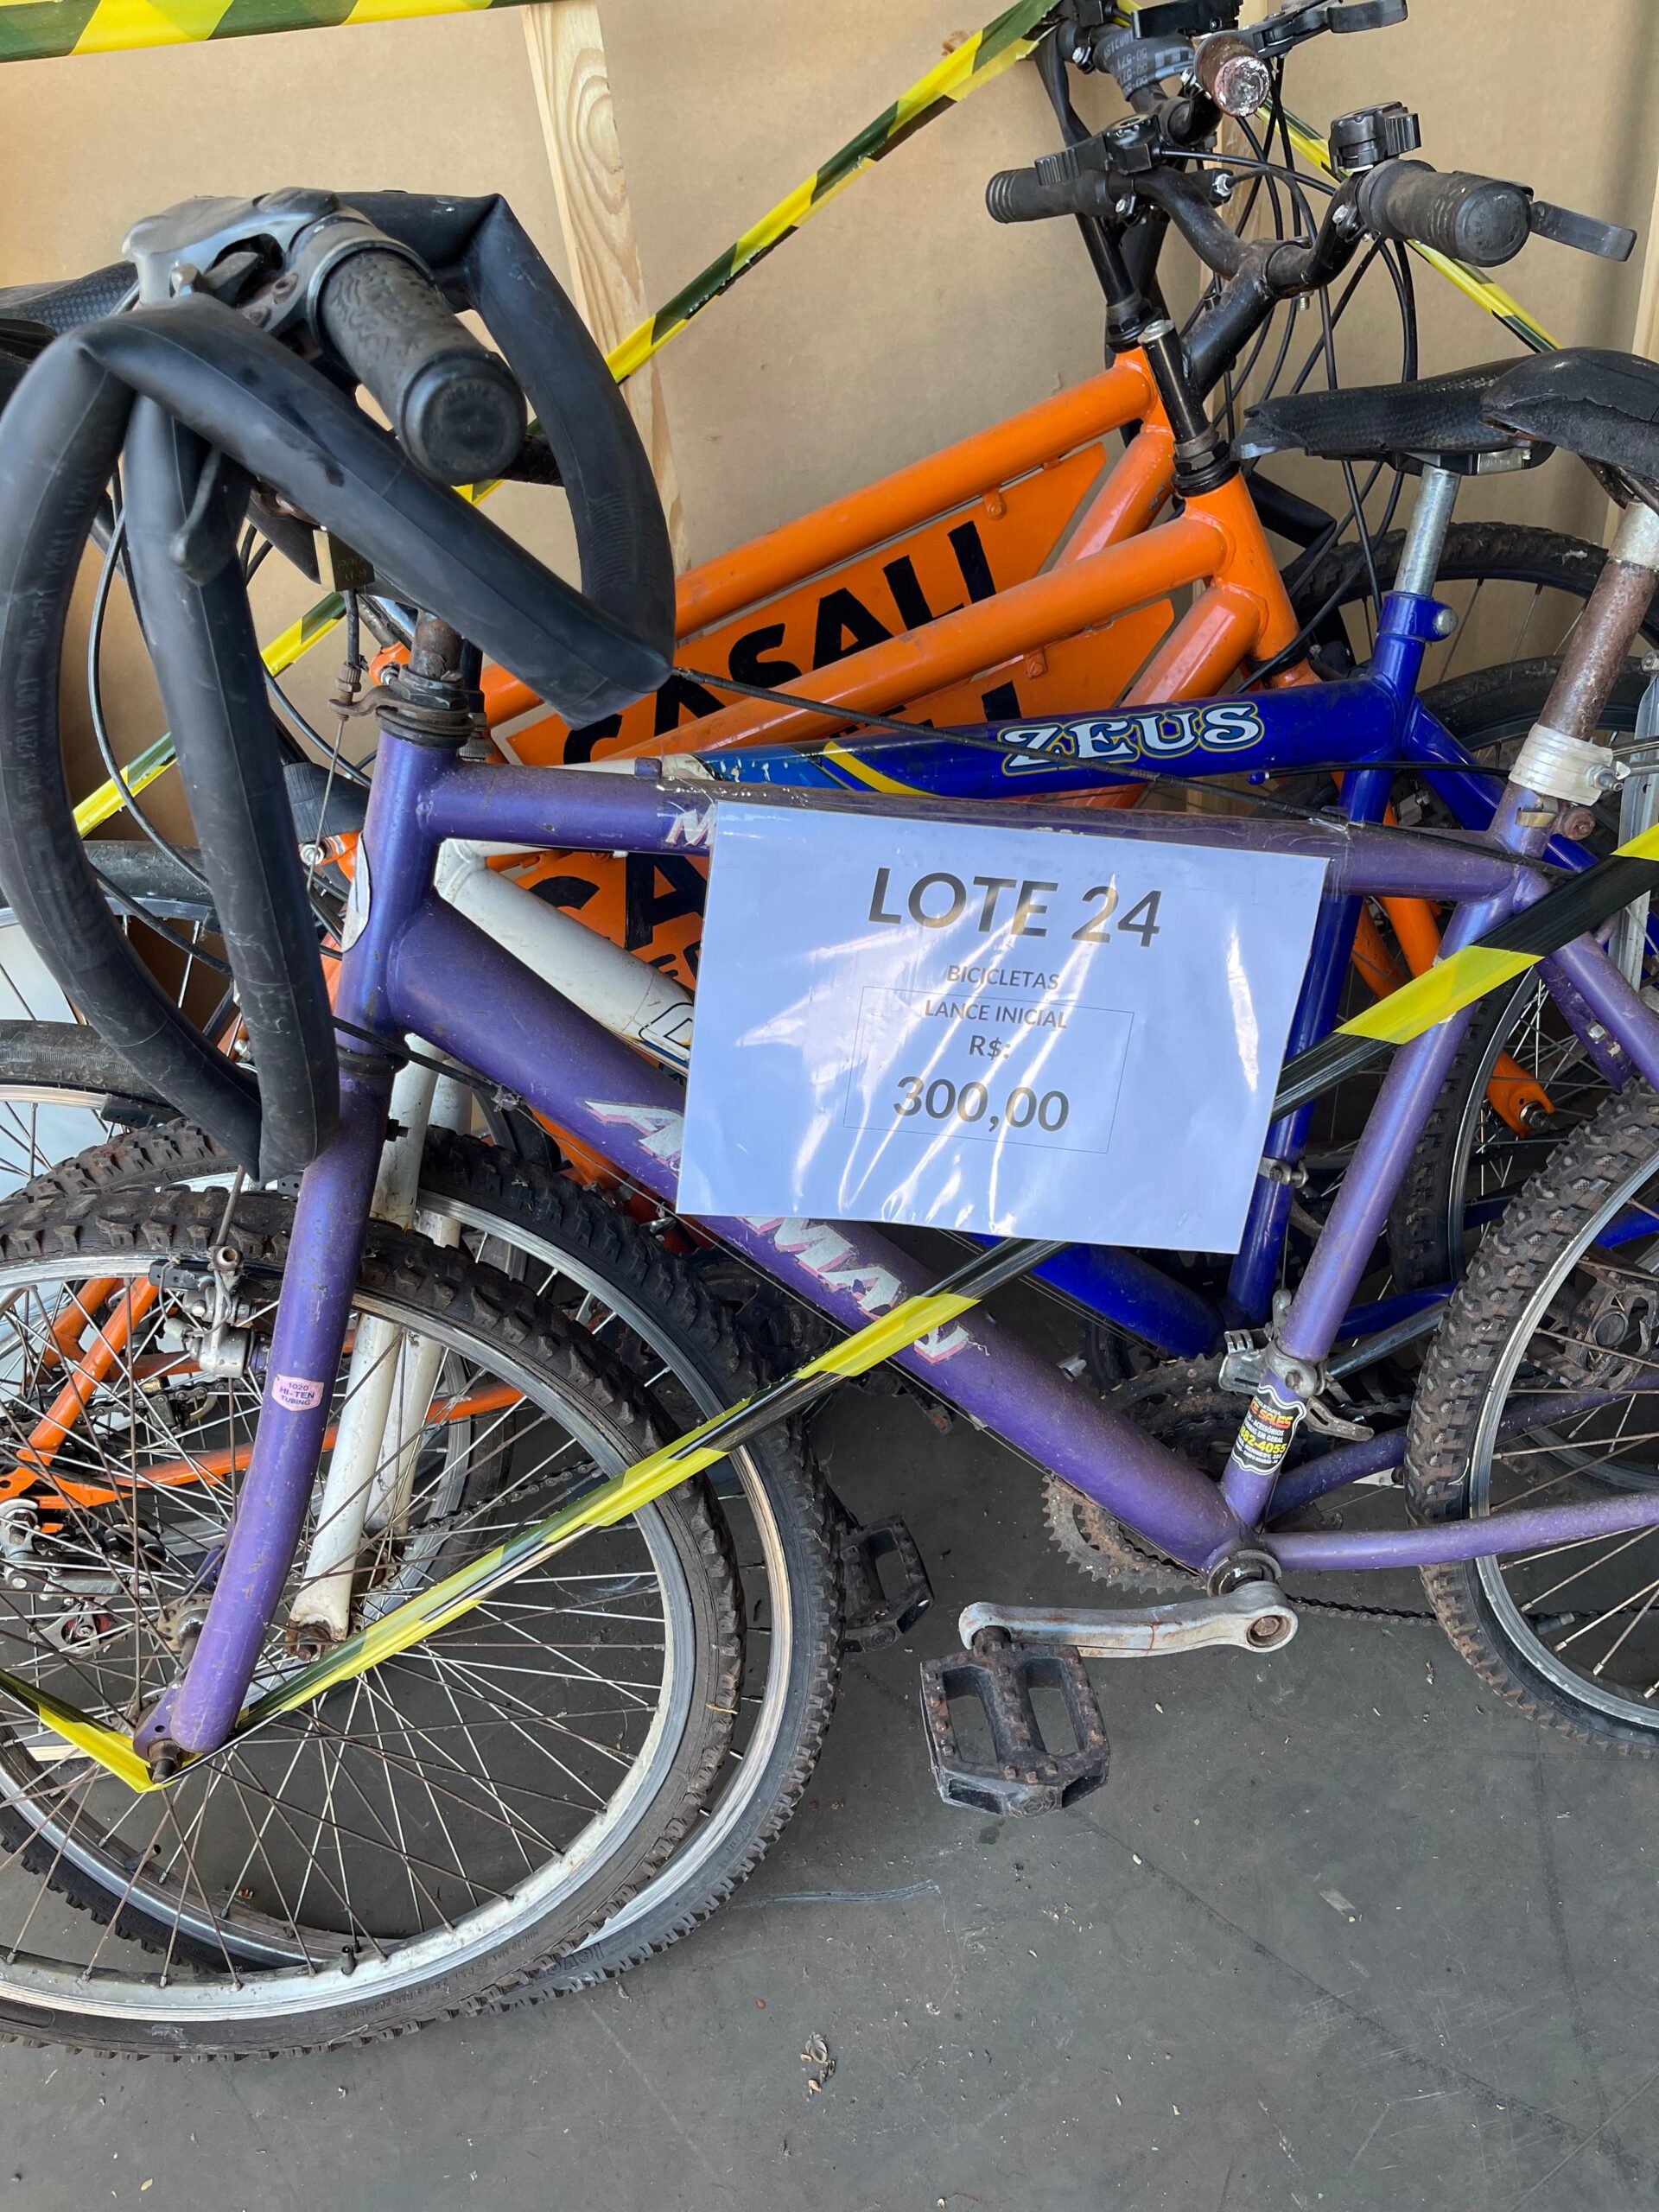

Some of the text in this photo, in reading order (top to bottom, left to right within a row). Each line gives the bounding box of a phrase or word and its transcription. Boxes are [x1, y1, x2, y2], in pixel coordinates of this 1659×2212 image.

[996, 702, 1265, 777] ZEUS
[867, 867, 1162, 948] LOTE 24
[947, 964, 1060, 991] BICICLETAS
[925, 1000, 1068, 1030] LANCE INICIAL
[969, 1034, 1012, 1061] R$:
[893, 1076, 1071, 1134] 300,00
[288, 1382, 309, 1391] 1020
[281, 1395, 311, 1406] TUBING
[1258, 1409, 1294, 1429] SALES
[1266, 1433, 1284, 1444] GERAL
